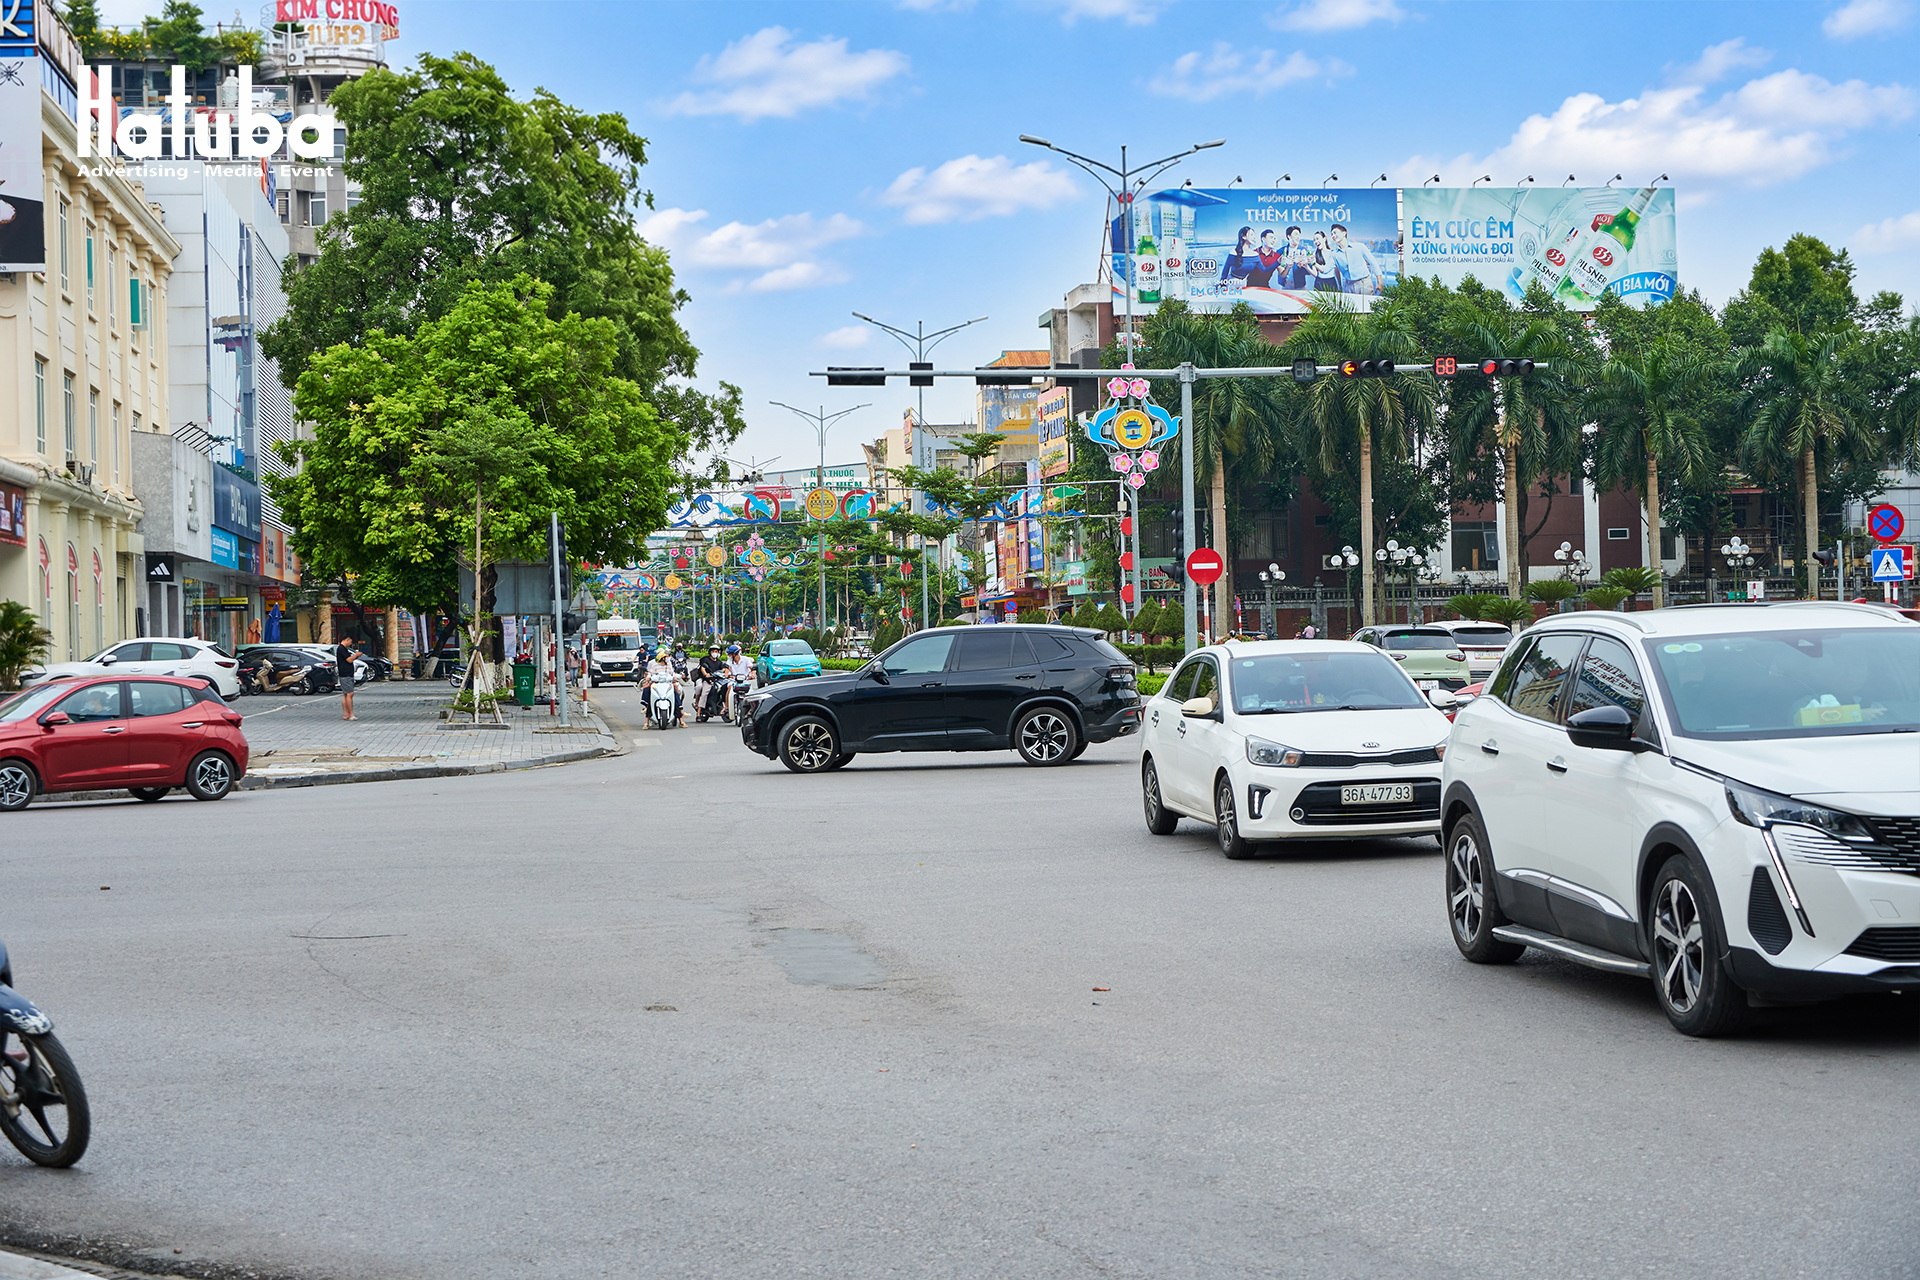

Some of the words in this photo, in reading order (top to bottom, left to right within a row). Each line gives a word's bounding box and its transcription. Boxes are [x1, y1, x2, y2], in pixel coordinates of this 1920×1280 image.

[276, 0, 319, 22] KIM
[326, 0, 400, 27] CHUNG
[1286, 195, 1300, 204] DỊP
[1244, 205, 1288, 222] THÊM
[1292, 203, 1320, 222] KẾT
[1322, 203, 1351, 222] NỐI
[1412, 216, 1440, 238] ÊM
[1445, 218, 1480, 241] CỰC
[1486, 216, 1514, 238] ÊM
[1412, 240, 1446, 254] XỨNG
[1450, 243, 1488, 254] MONG
[1490, 242, 1513, 256] ĐỢI
[1191, 260, 1216, 270] COLD
[1532, 258, 1560, 284] PILSNER
[1577, 258, 1608, 284] PILSNER
[1190, 286, 1205, 296] ÊM
[1622, 276, 1642, 293] BIA
[1644, 274, 1670, 292] MỚI
[1436, 357, 1456, 376] 68
[1344, 786, 1410, 802] 36A-477.93
